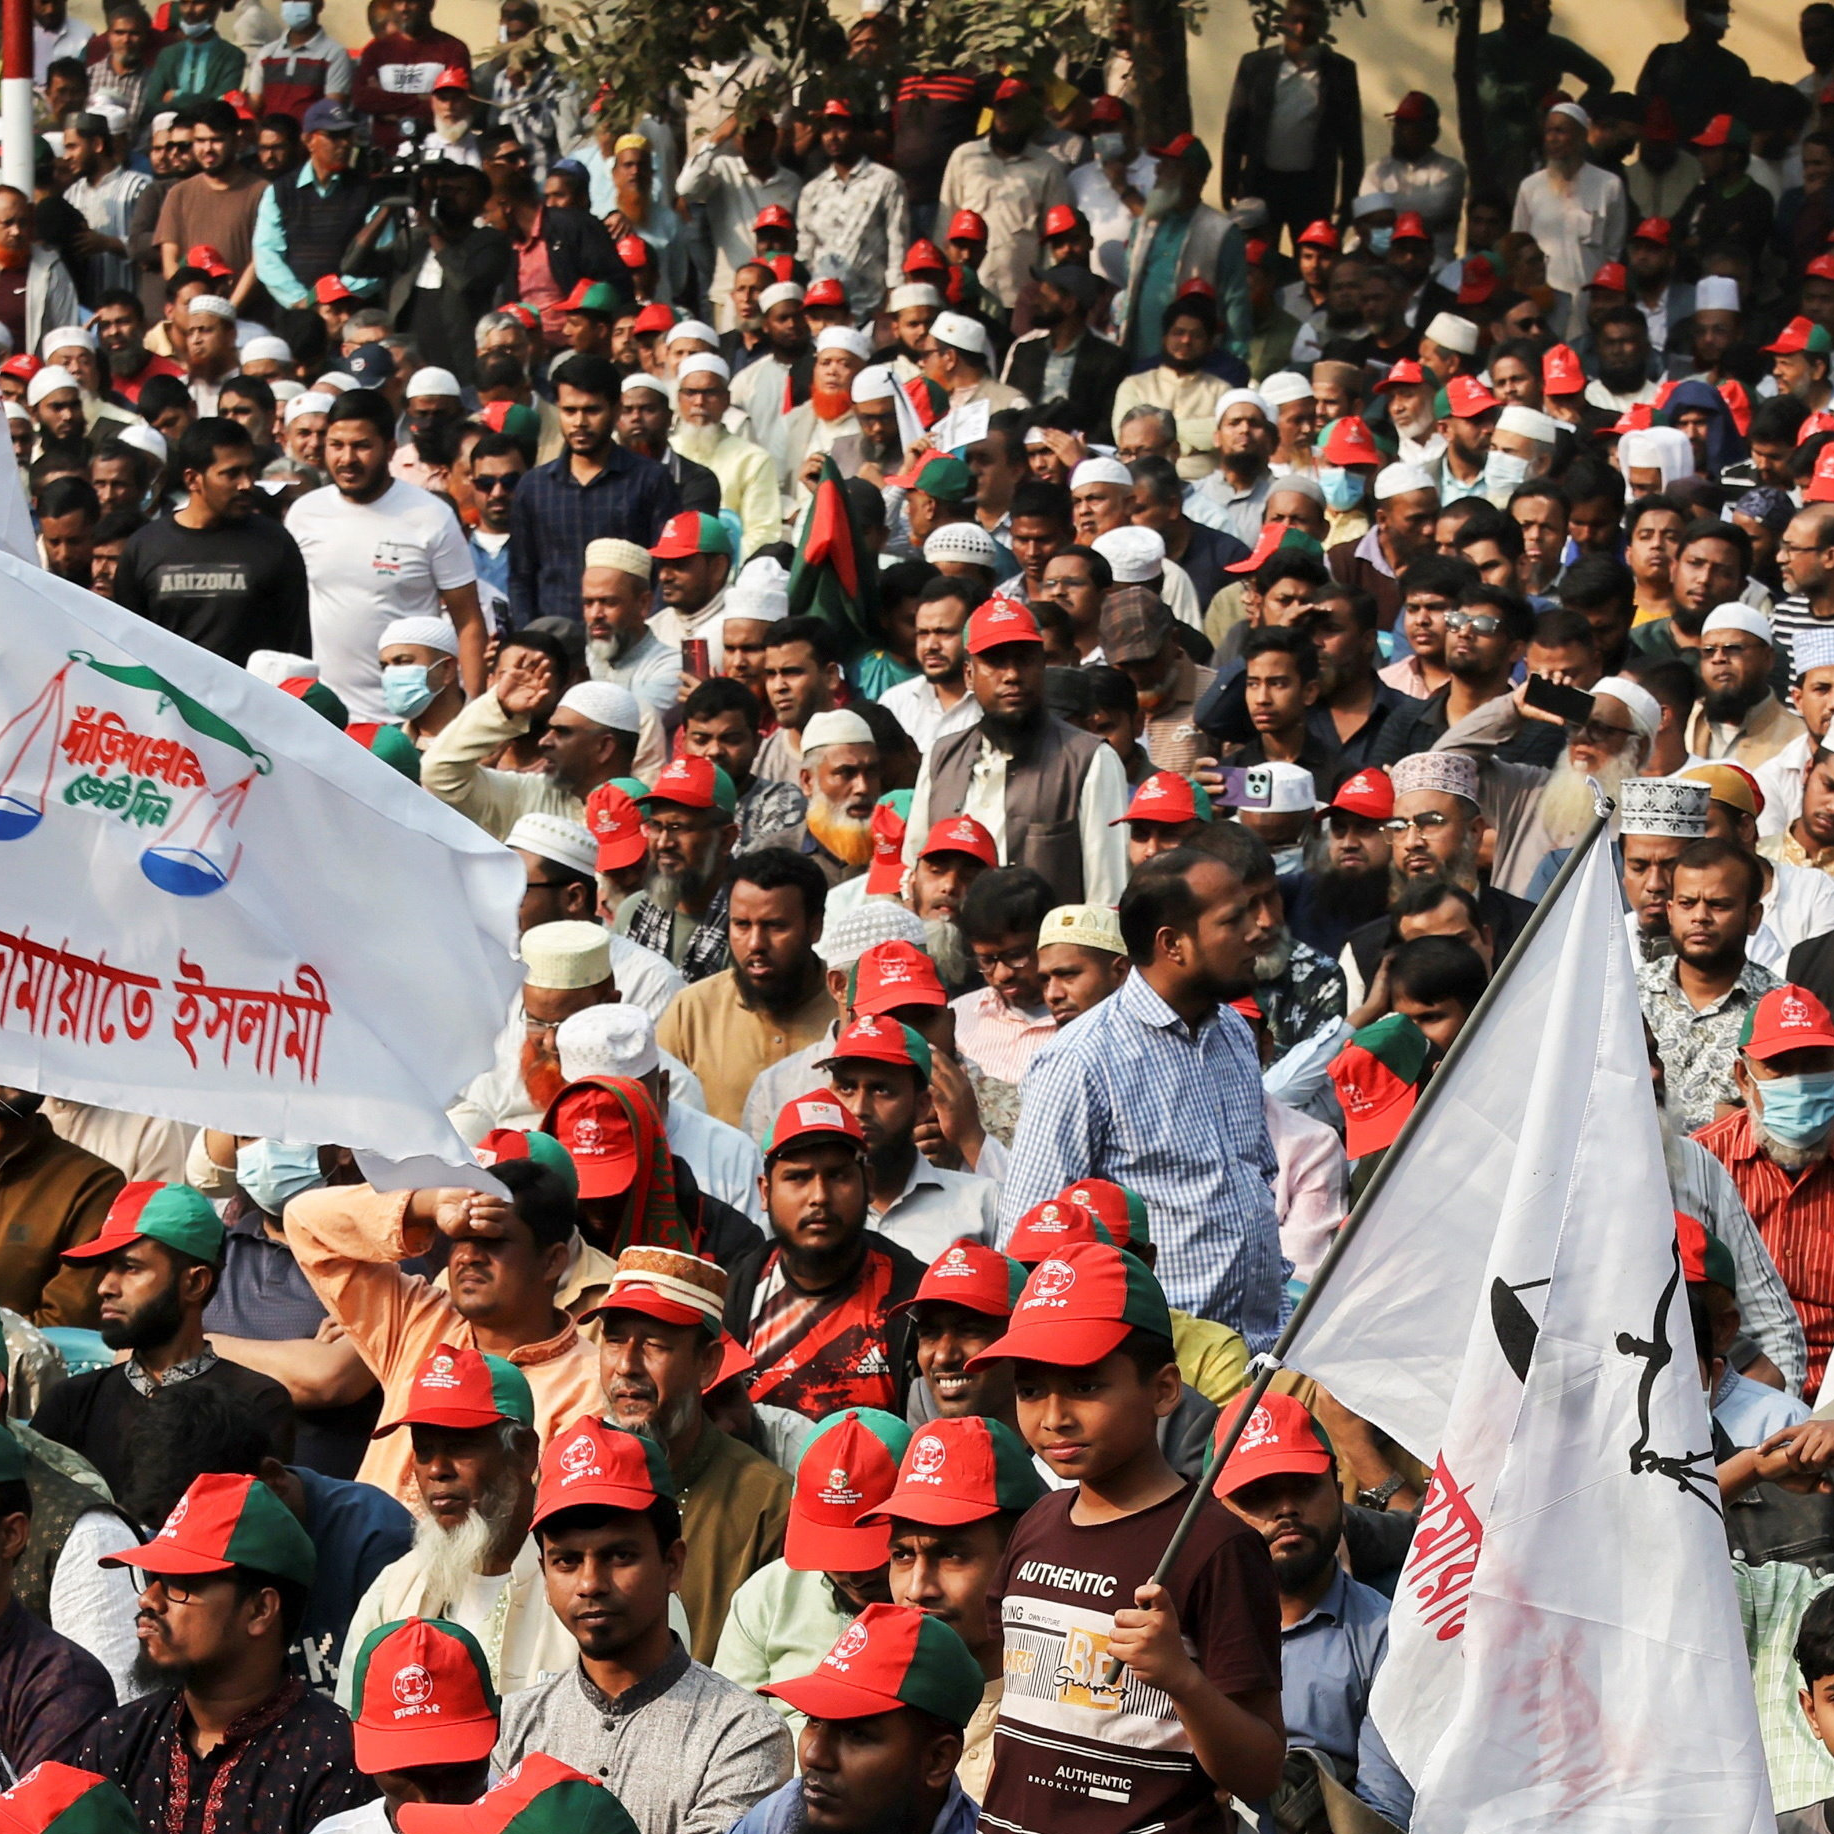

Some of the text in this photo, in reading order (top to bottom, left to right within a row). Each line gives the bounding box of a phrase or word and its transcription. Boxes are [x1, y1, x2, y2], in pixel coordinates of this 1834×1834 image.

[161, 571, 247, 592] ARIZONA
[120, 779, 174, 829] দিন
[170, 948, 332, 1084] ইসলামী
[1022, 1297, 1068, 1310] ঢাকা-১৫
[857, 1361, 890, 1375] adidas
[1239, 1435, 1279, 1453] ঢাকা-১৫
[561, 1469, 601, 1486] ঢাকা-১৫
[906, 1473, 943, 1486] ঢাকা-১৫
[1016, 1561, 1118, 1598] AUTHENTIC
[393, 1704, 440, 1720] ঢাকা-১৫
[1027, 1774, 1088, 1795] BROOKLYN
[1055, 1764, 1133, 1791] AUTHENTIC
